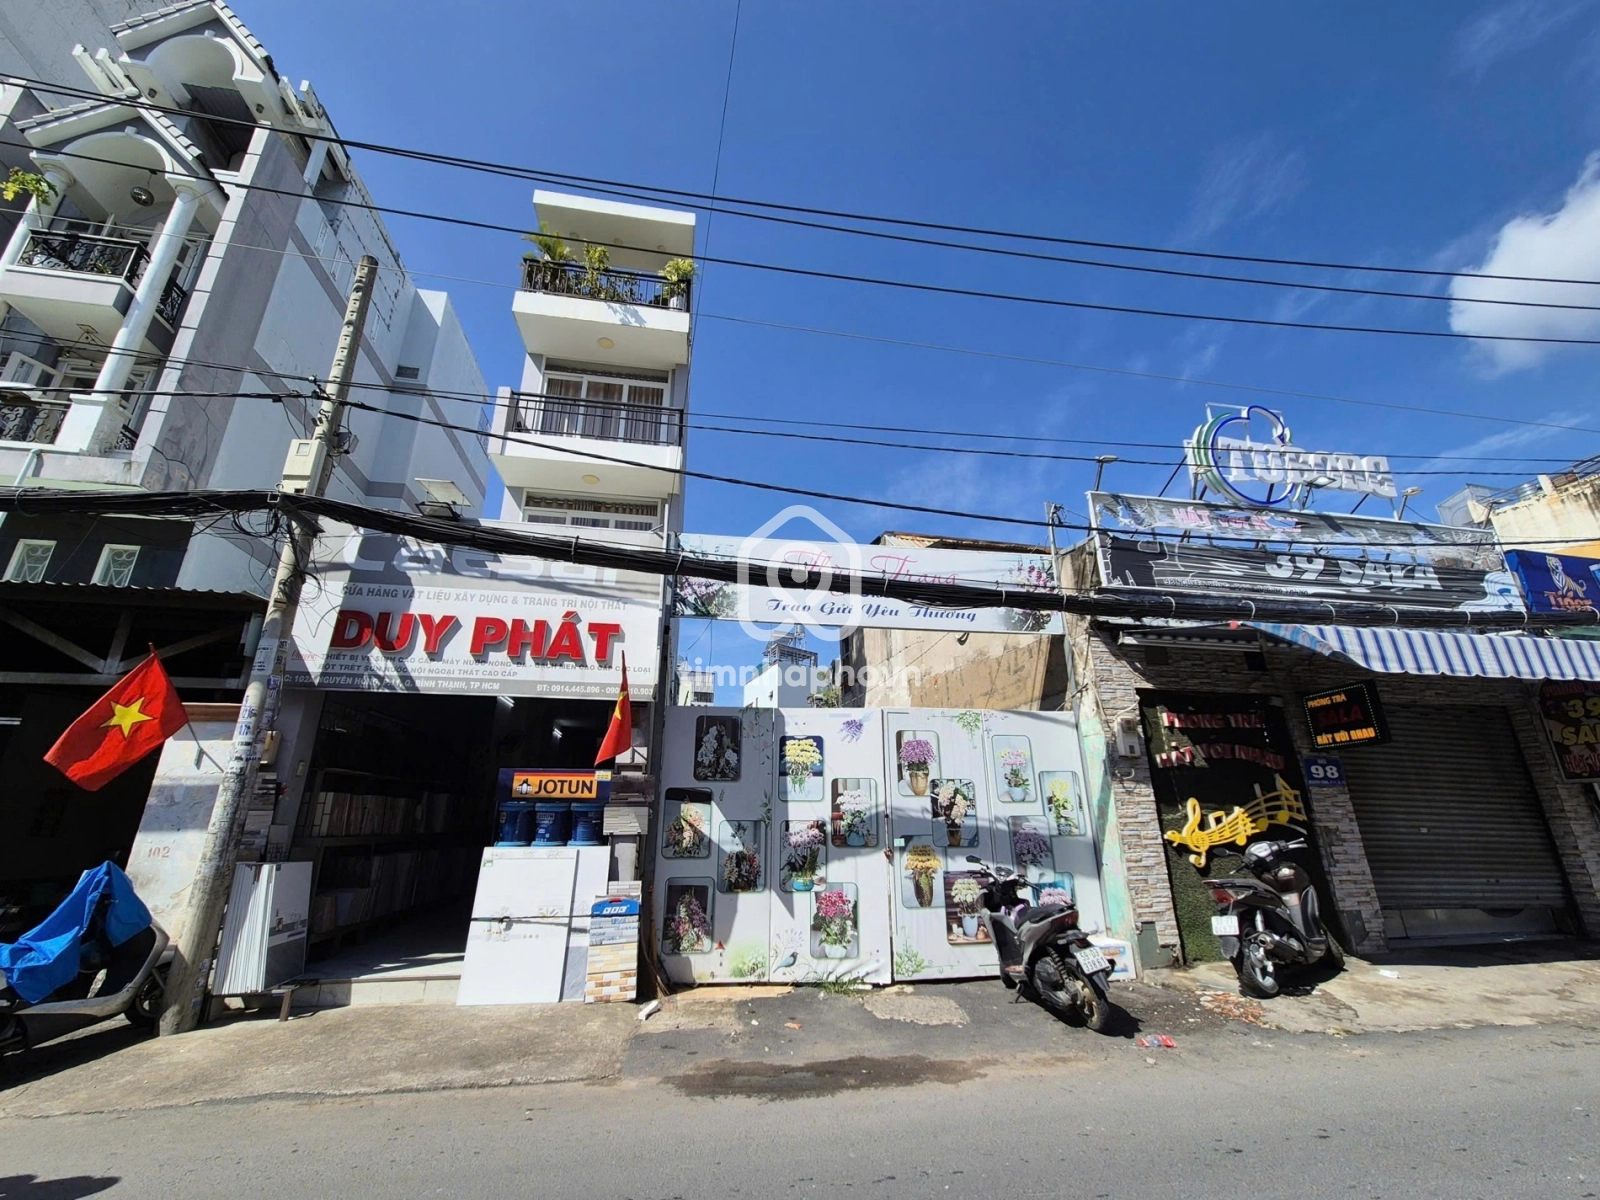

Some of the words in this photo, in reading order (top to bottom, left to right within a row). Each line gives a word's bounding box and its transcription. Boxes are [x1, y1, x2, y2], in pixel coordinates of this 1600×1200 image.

[342, 584, 364, 598] CỬA
[366, 585, 398, 598] HÀNG
[402, 587, 426, 602] VẬT
[426, 589, 452, 603] LIỆU
[454, 590, 476, 602] XÂY
[479, 592, 508, 606] DỰNG
[511, 596, 518, 605] &
[523, 596, 558, 608] TRANG
[580, 599, 598, 612] NỘI
[601, 598, 628, 611] THẤT
[766, 598, 811, 613] Trao
[861, 603, 899, 618] Yêu
[330, 609, 458, 654] DUY
[470, 611, 620, 661] PHÁT
[615, 665, 631, 673] CC
[470, 682, 480, 690] TP
[481, 682, 500, 690] HCM
[537, 683, 550, 693] ĐT:
[1310, 765, 1339, 779] 98
[534, 779, 593, 795] JOTUN
[147, 845, 171, 859] 102
